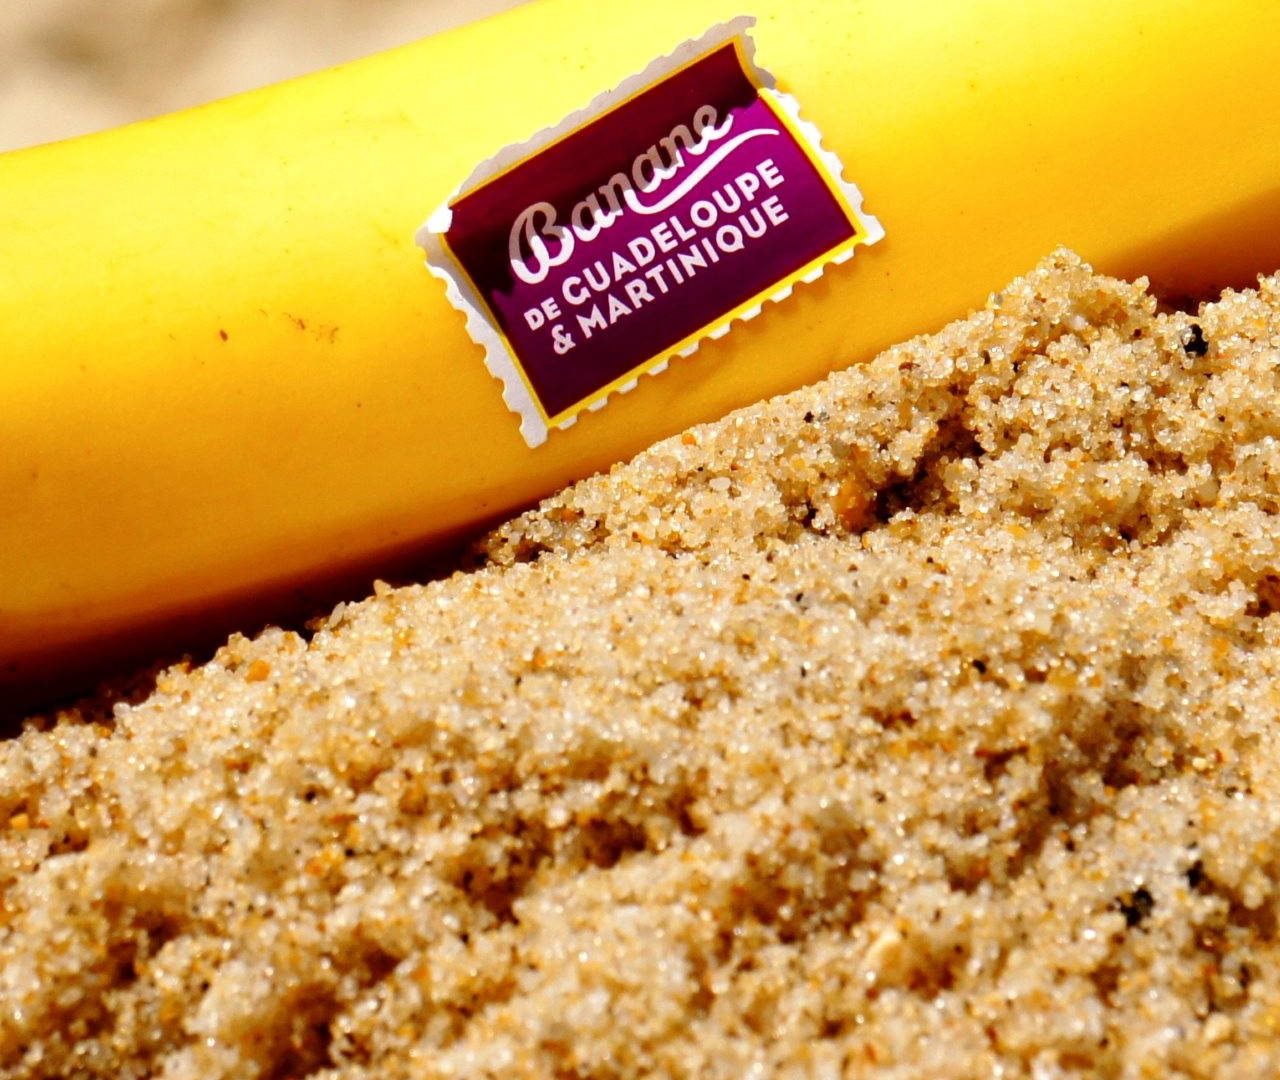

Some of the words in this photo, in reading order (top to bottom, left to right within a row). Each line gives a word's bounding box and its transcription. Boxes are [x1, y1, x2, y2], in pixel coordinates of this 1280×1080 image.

[507, 103, 780, 285] Banane
[523, 296, 562, 331] DE
[561, 158, 785, 305] GUADELOUPE
[551, 324, 576, 355] &
[576, 195, 789, 339] MARTINIQUE
